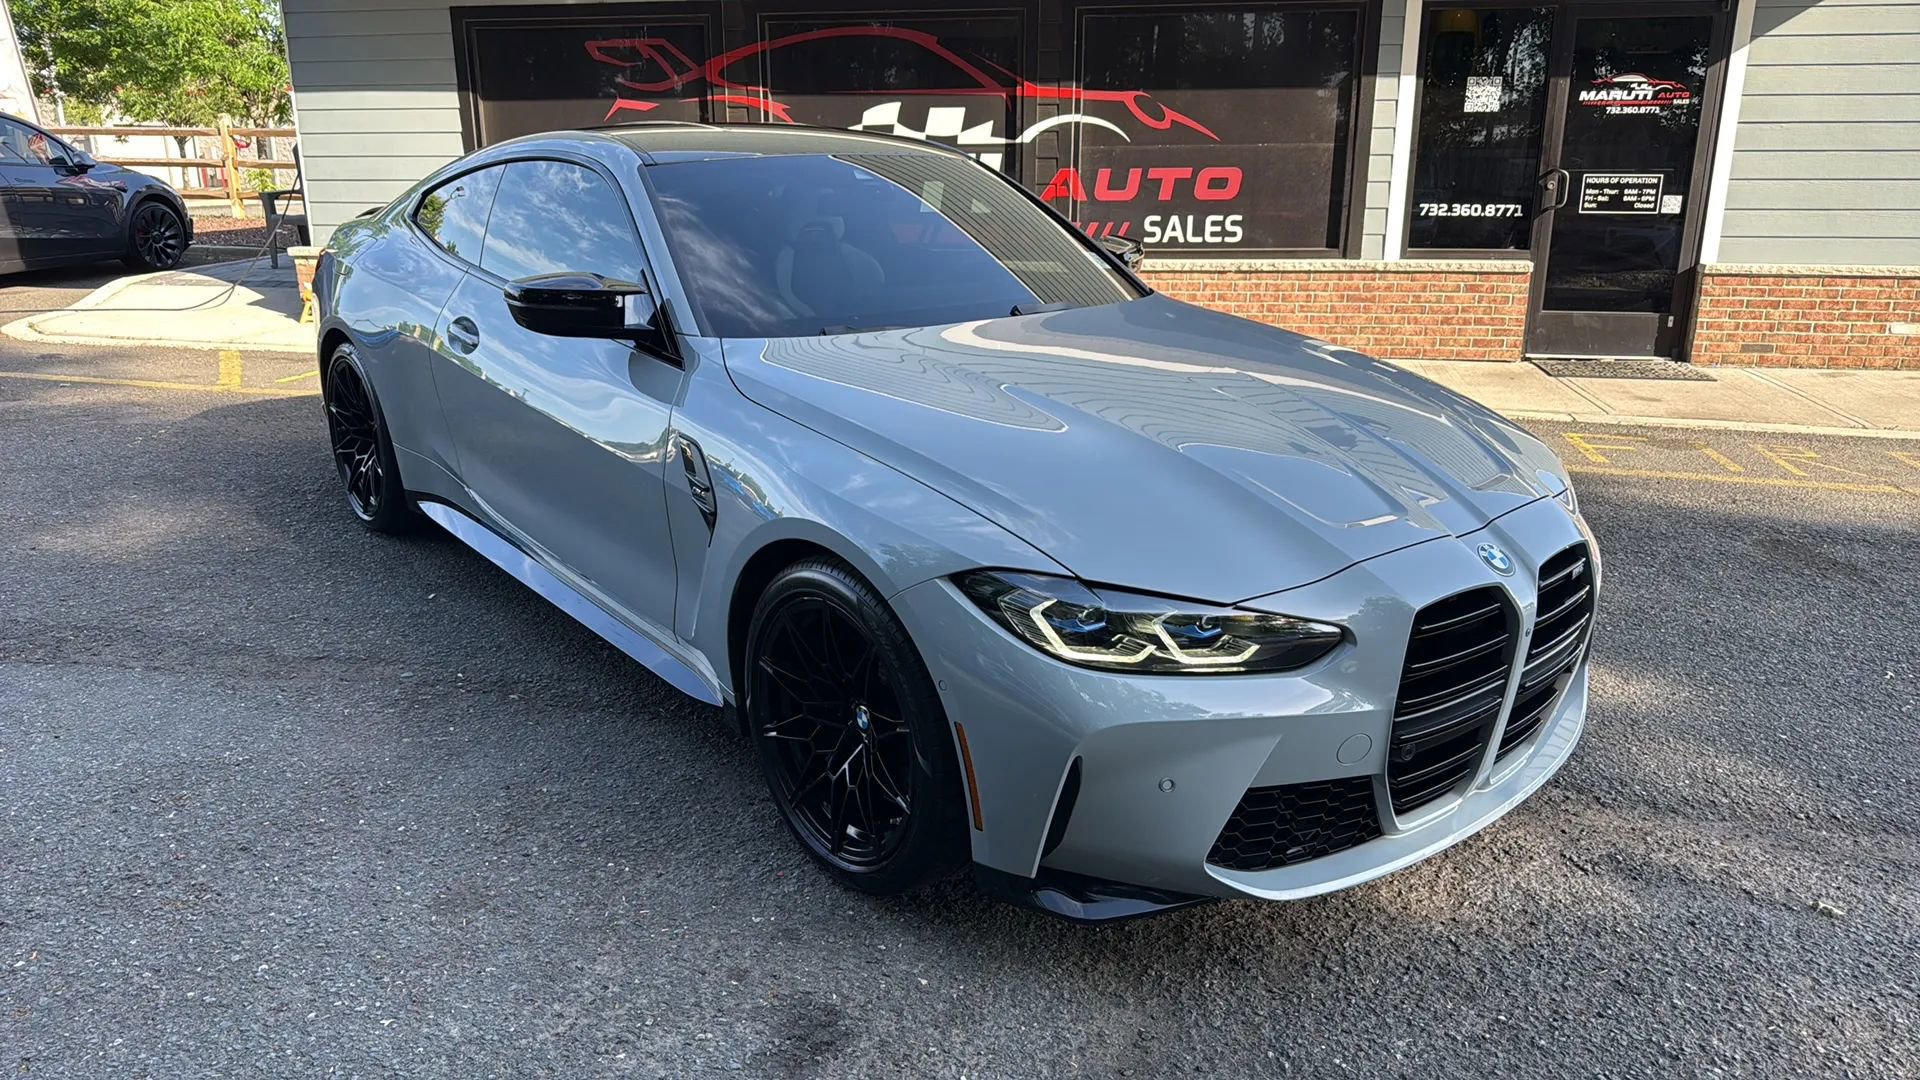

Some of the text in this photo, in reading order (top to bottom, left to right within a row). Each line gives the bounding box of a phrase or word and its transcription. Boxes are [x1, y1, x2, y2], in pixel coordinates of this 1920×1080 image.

[1579, 90, 1690, 101] MARUTI AUTO
[1605, 106, 1661, 114] 732.360.8771
[1040, 167, 1243, 202] AUTO
[1419, 203, 1523, 217] 732.360.8771
[1143, 214, 1243, 243] SALES
